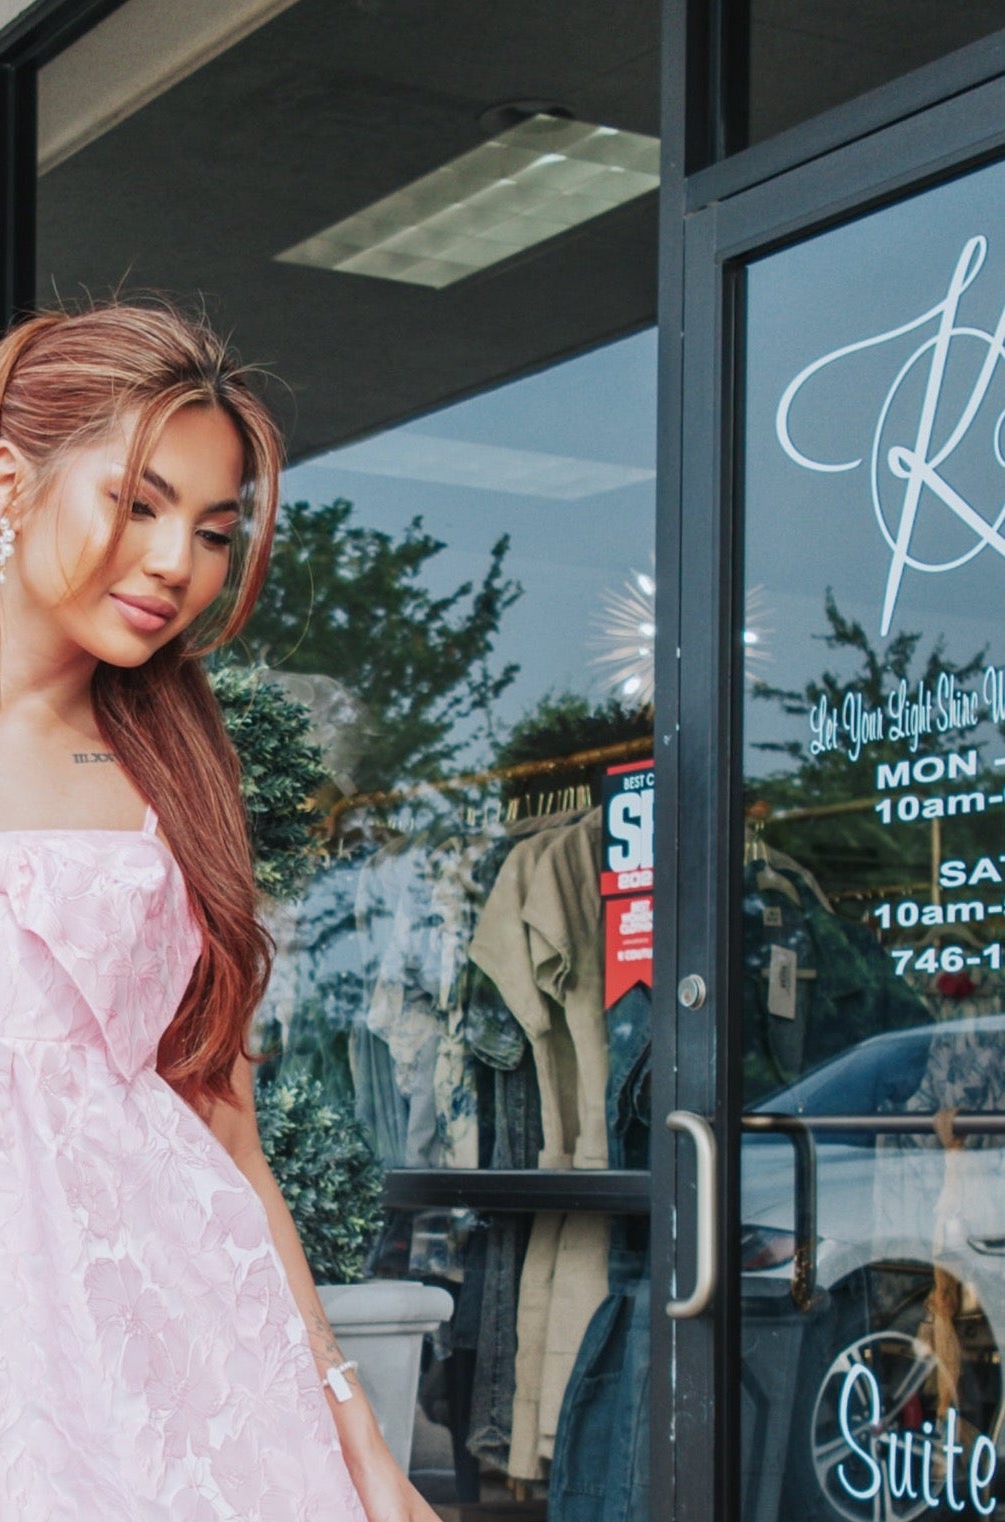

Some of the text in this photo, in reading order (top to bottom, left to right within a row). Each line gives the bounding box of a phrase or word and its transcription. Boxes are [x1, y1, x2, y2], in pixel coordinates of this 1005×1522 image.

[810, 695, 838, 755] Let
[842, 692, 884, 762] Your
[889, 678, 932, 752] Light
[936, 672, 979, 732] Shine
[623, 774, 646, 791] BEST
[877, 750, 977, 790] MON
[875, 792, 1005, 824] 10am-
[874, 901, 1005, 929] 10am-
[838, 1363, 996, 1516] Suite
